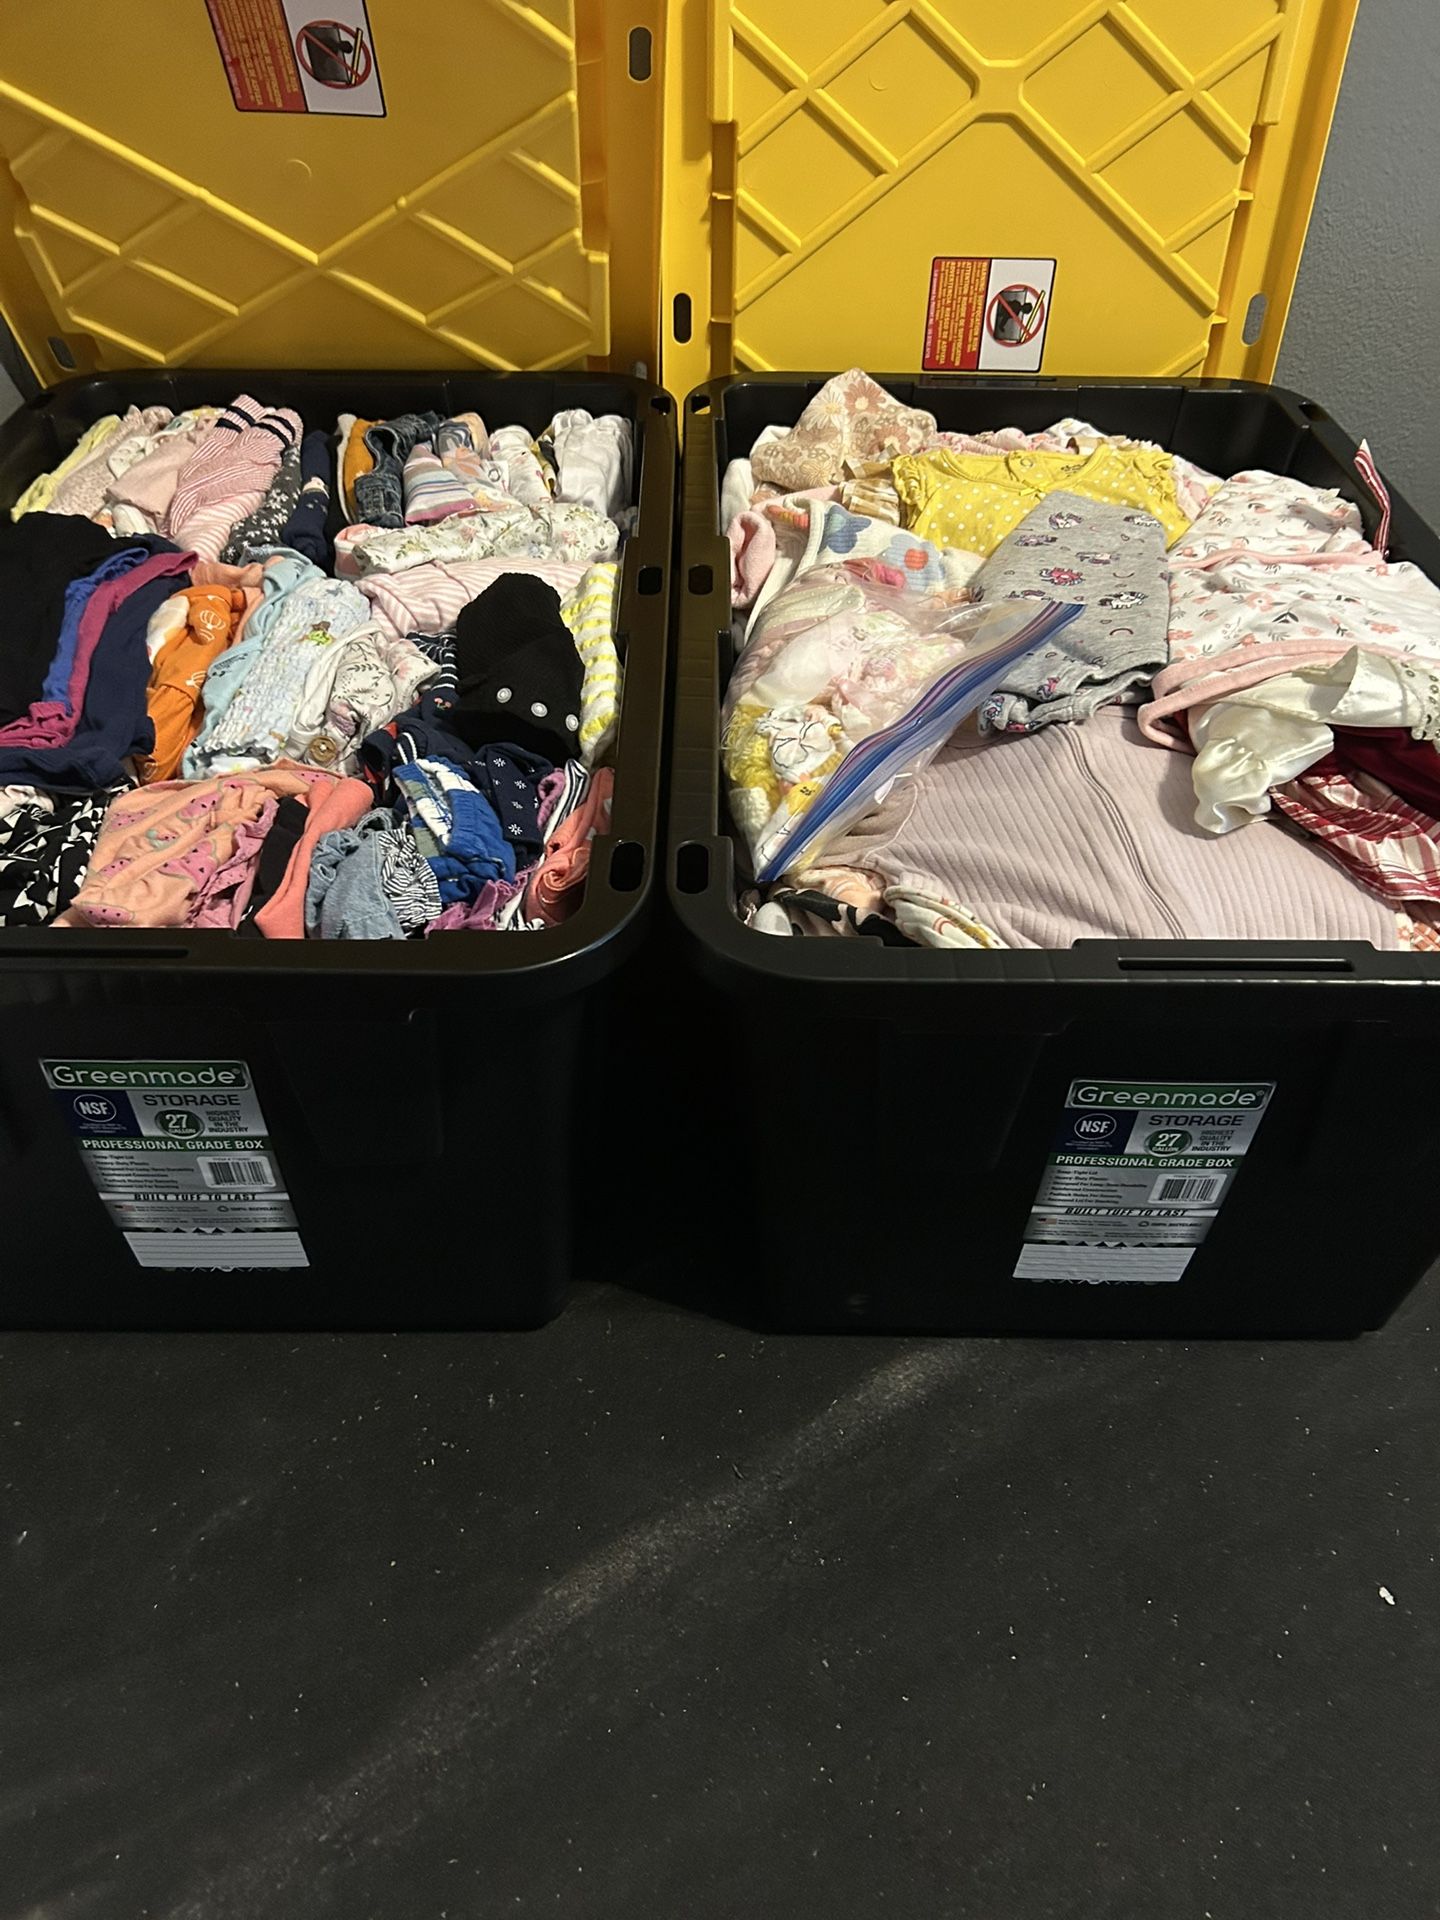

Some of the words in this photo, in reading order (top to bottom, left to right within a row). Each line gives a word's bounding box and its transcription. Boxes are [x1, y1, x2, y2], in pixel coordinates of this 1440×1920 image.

[53, 1066, 236, 1085] Greenmade
[143, 1095, 241, 1106] STORAGE
[1077, 1086, 1256, 1106] Greenmade
[79, 1101, 108, 1116] NSF
[165, 1114, 188, 1128] 27
[1079, 1120, 1110, 1133] NSF
[1149, 1115, 1244, 1126] STORAGE
[82, 1139, 187, 1150] PROFESSIONAL
[187, 1140, 233, 1150] GRADE
[235, 1140, 264, 1150] BOX
[1155, 1134, 1182, 1147] 27
[1055, 1156, 1154, 1167] PROFESSIONAL
[1158, 1158, 1203, 1168] GRADE
[1207, 1158, 1235, 1168] BOX
